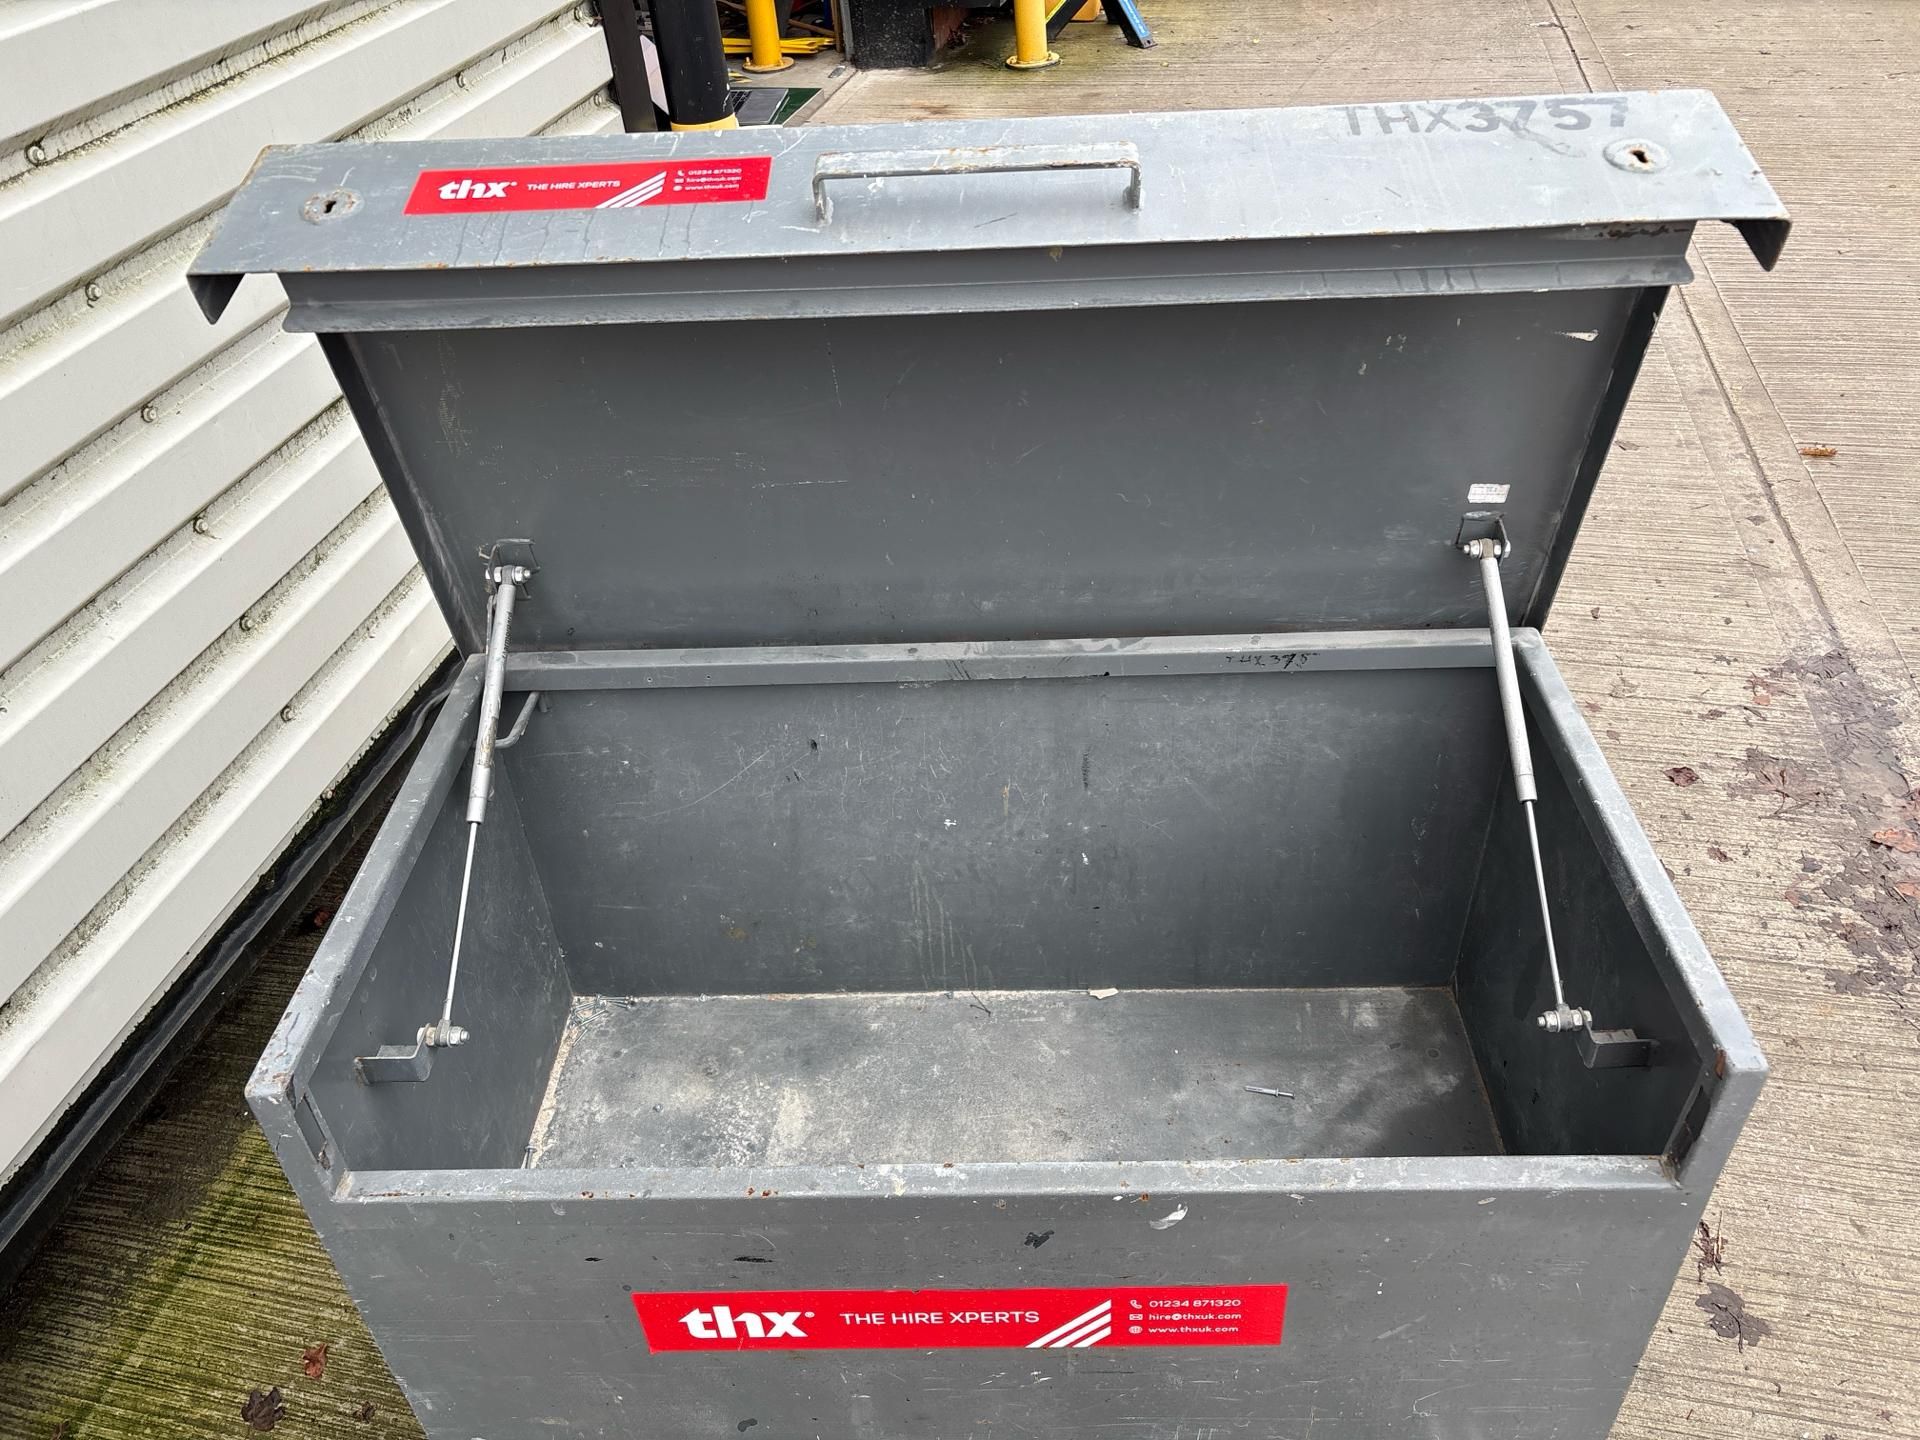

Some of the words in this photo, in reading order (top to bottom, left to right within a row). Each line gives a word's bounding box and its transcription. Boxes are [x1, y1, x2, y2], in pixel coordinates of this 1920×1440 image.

[526, 183, 549, 192] THE
[551, 182, 576, 190] HIRE
[577, 180, 621, 190] XPERTS
[1149, 1300, 1190, 1308] 01234
[1192, 1299, 1242, 1307] 871320
[840, 1312, 886, 1325] THE
[891, 1312, 944, 1324] HIRE
[949, 1311, 1040, 1324] XPERTS
[1149, 1313, 1242, 1321] hire@thxuk.com
